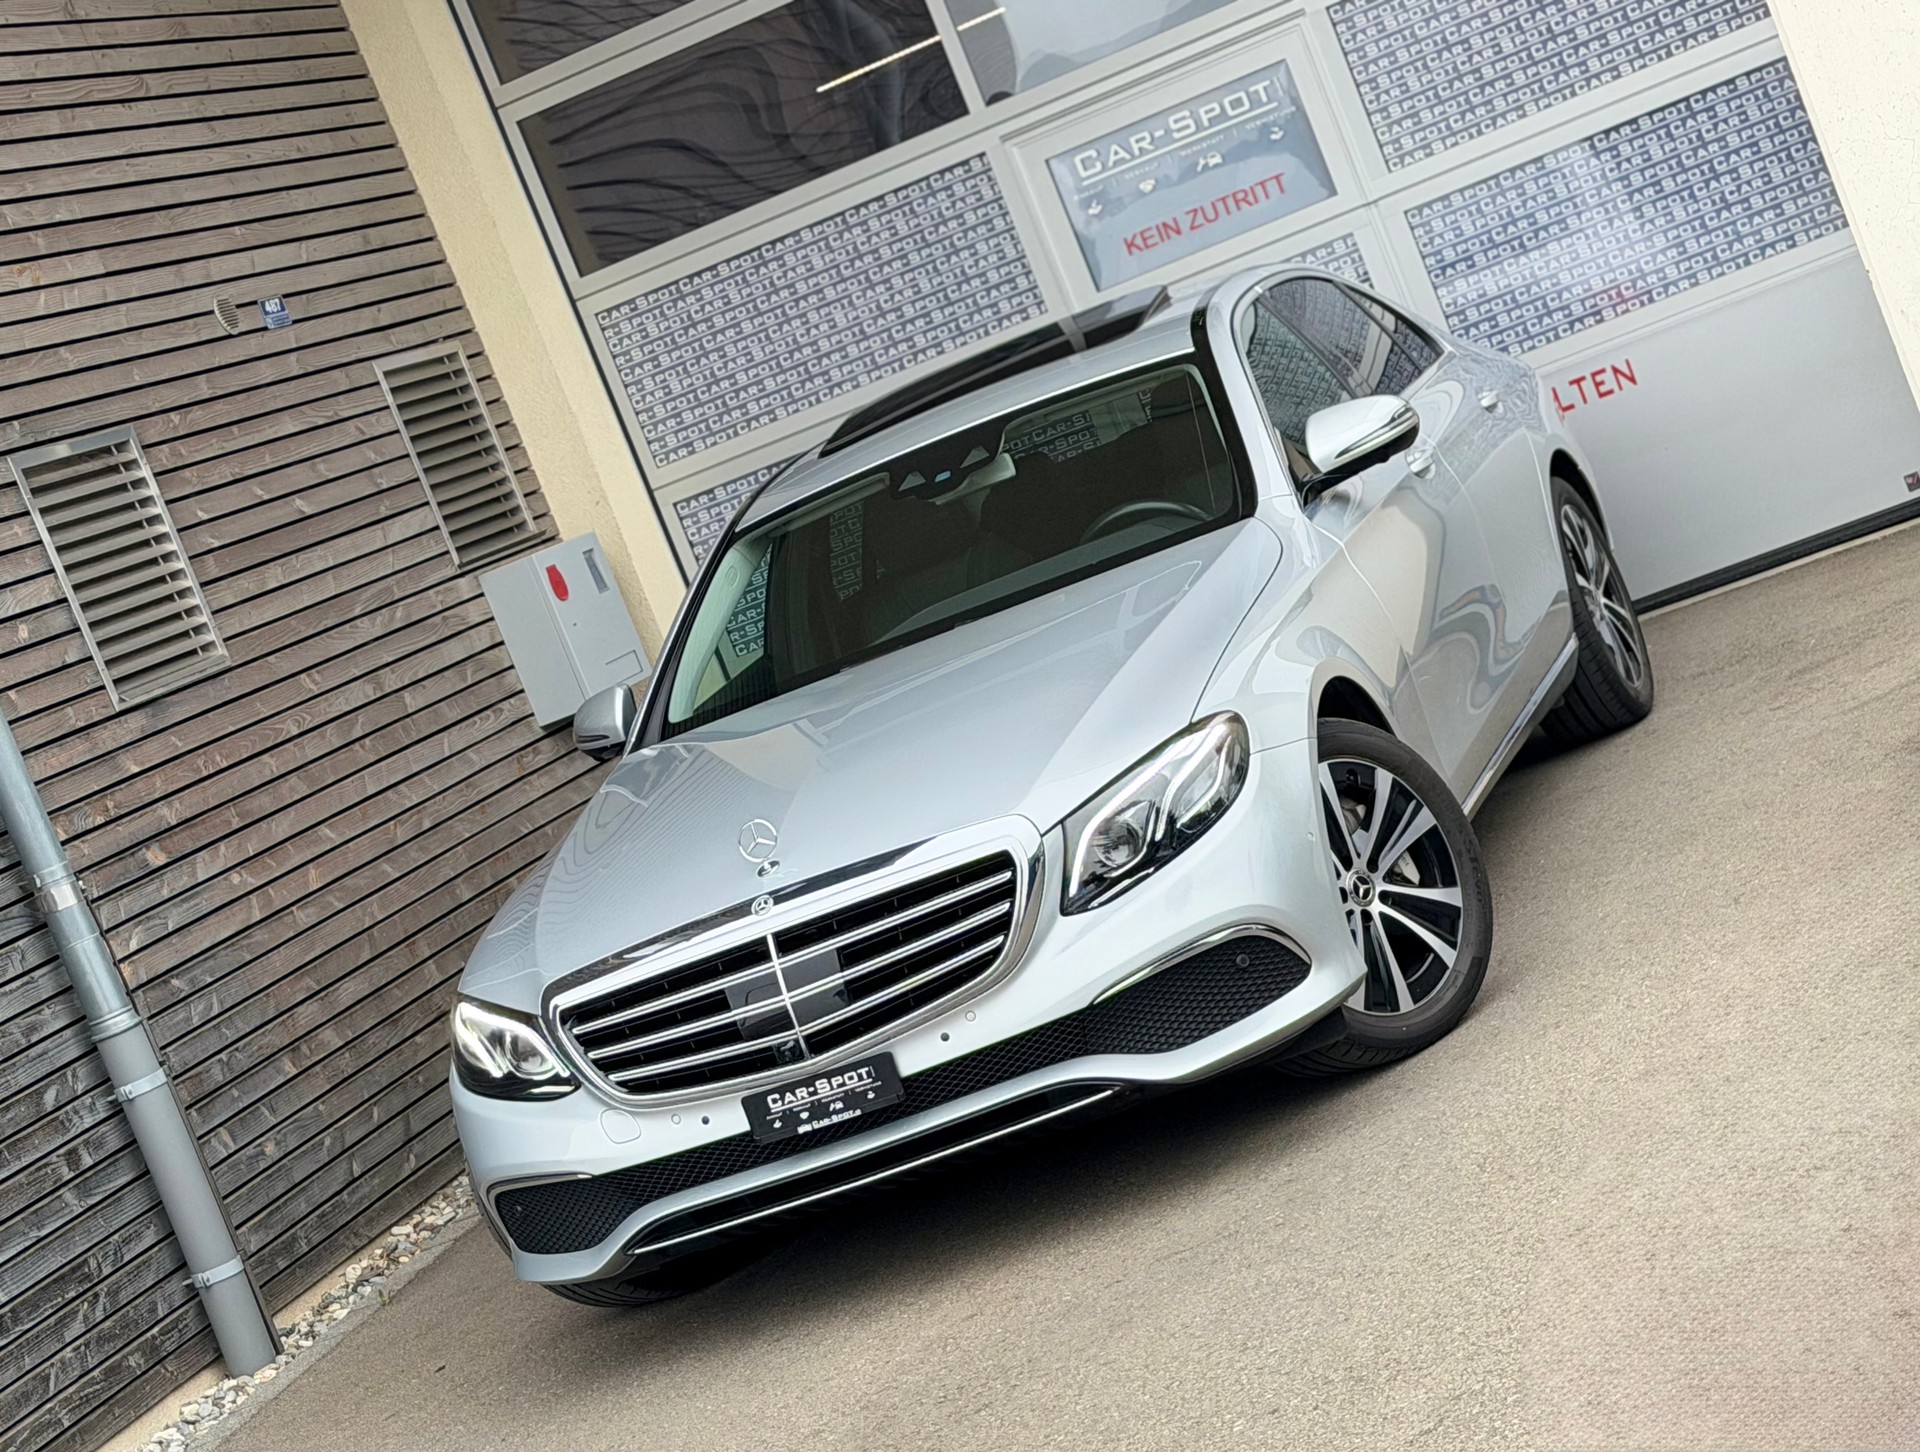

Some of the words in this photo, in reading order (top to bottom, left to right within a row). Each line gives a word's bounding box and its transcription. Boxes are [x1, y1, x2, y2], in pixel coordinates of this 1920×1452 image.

[1340, 2, 1430, 49] CAR-SPOT
[1352, 34, 1442, 80] CAR-SPOT
[1364, 63, 1453, 109] CAR-SPOT
[1456, 24, 1547, 71] CAR-SPOT
[1375, 95, 1465, 141] CAR-SPOT
[1468, 56, 1559, 102] CAR-SPOT
[1561, 16, 1655, 64] CAR-SPOT
[1425, 20, 1517, 67] CAR-SPOT
[1436, 50, 1528, 97] CAR-SPOT
[1530, 10, 1623, 58] CAR-SPOT
[1448, 82, 1540, 129] CAR-SPOT
[1542, 43, 1635, 90] CAR-SPOT
[1637, 2, 1733, 50] CAR-SPOT
[1074, 80, 1271, 178] CAR-SPOT
[1388, 126, 1477, 172] CAR-SPOT
[1479, 87, 1571, 134] CAR-SPOT
[1573, 48, 1667, 95] CAR-SPOT
[1669, 7, 1765, 55] CAR-SPOT
[1406, 178, 1496, 223] CAR-SPOT
[1497, 140, 1590, 186] CAR-SPOT
[1591, 101, 1686, 148] CAR-SPOT
[1688, 61, 1784, 109] CAR-SPOT
[1478, 165, 1571, 212] CAR-SPOT
[1572, 127, 1666, 174] CAR-SPOT
[1668, 88, 1763, 135] CAR-SPOT
[1123, 217, 1182, 256] KEIN
[1185, 172, 1287, 232] ZUTRITT
[1417, 207, 1508, 252] CAR-SPOT
[1509, 169, 1602, 215] CAR-SPOT
[1603, 131, 1698, 178] CAR-SPOT
[1699, 91, 1796, 139] CAR-SPOT
[1430, 238, 1520, 283] CAR-SPOT
[1521, 201, 1613, 246] CAR-SPOT
[1615, 162, 1710, 209] CAR-SPOT
[1711, 123, 1808, 171] CAR-SPOT
[1490, 195, 1582, 241] CAR-SPOT
[1583, 157, 1678, 203] CAR-SPOT
[1679, 118, 1775, 165] CAR-SPOT
[1502, 226, 1594, 271] CAR-SPOT
[1595, 188, 1690, 234] CAR-SPOT
[1691, 150, 1787, 197] CAR-SPOT
[596, 283, 677, 325] CAR-SPOT
[677, 249, 759, 292] CAR-SPOT
[760, 214, 842, 258] CAR-SPOT
[843, 179, 927, 223] CAR-SPOT
[607, 311, 688, 353] CAR-SPOT
[689, 277, 770, 319] CAR-SPOT
[771, 242, 853, 285] CAR-SPOT
[854, 207, 938, 251] CAR-SPOT
[661, 273, 743, 315] CAR-SPOT
[743, 239, 826, 281] CAR-SPOT
[826, 204, 910, 247] CAR-SPOT
[672, 301, 754, 343] CAR-SPOT
[754, 266, 837, 309] CAR-SPOT
[837, 232, 921, 275] CAR-SPOT
[1441, 267, 1531, 312] CAR-SPOT
[1532, 230, 1625, 276] CAR-SPOT
[1626, 192, 1721, 239] CAR-SPOT
[1722, 153, 1819, 200] CAR-SPOT
[1477, 324, 1524, 351] SPOT
[1525, 287, 1617, 332] CAR-SPOT
[1619, 250, 1713, 295] CAR-SPOT
[1714, 212, 1810, 258] CAR-SPOT
[1507, 330, 1555, 357] SPOT
[1556, 293, 1649, 338] CAR-SPOT
[1650, 255, 1745, 301] CAR-SPOT
[1746, 217, 1843, 264] CAR-SPOT
[1513, 256, 1605, 301] CAR-SPOT
[1607, 218, 1701, 264] CAR-SPOT
[1702, 180, 1798, 227] CAR-SPOT
[1544, 262, 1637, 307] CAR-SPOT
[1638, 224, 1733, 270] CAR-SPOT
[1734, 185, 1831, 232] CAR-SPOT
[265, 298, 281, 313] 487
[619, 340, 700, 382] CAR-SPOT
[700, 306, 782, 349] CAR-SPOT
[783, 272, 865, 315] CAR-SPOT
[866, 238, 950, 281] CAR-SPOT
[630, 368, 711, 409] CAR-SPOT
[712, 334, 793, 376] CAR-SPOT
[794, 300, 876, 343] CAR-SPOT
[877, 266, 961, 309] CAR-SPOT
[684, 330, 766, 372] CAR-SPOT
[766, 296, 849, 339] CAR-SPOT
[849, 262, 933, 305] CAR-SPOT
[695, 358, 777, 400] CAR-SPOT
[777, 324, 860, 367] CAR-SPOT
[860, 290, 944, 333] CAR-SPOT
[642, 397, 723, 438] CAR-SPOT
[723, 364, 805, 405] CAR-SPOT
[805, 330, 888, 372] CAR-SPOT
[889, 296, 973, 339] CAR-SPOT
[654, 427, 735, 468] CAR-SPOT
[735, 393, 817, 435] CAR-SPOT
[817, 360, 900, 402] CAR-SPOT
[901, 326, 984, 368] CAR-SPOT
[707, 388, 789, 429] CAR-SPOT
[789, 354, 872, 396] CAR-SPOT
[872, 320, 956, 362] CAR-SPOT
[1551, 358, 1638, 413] LTEN
[676, 475, 757, 514] CAR-SPOT
[767, 1066, 870, 1109] CAR-SPOT
